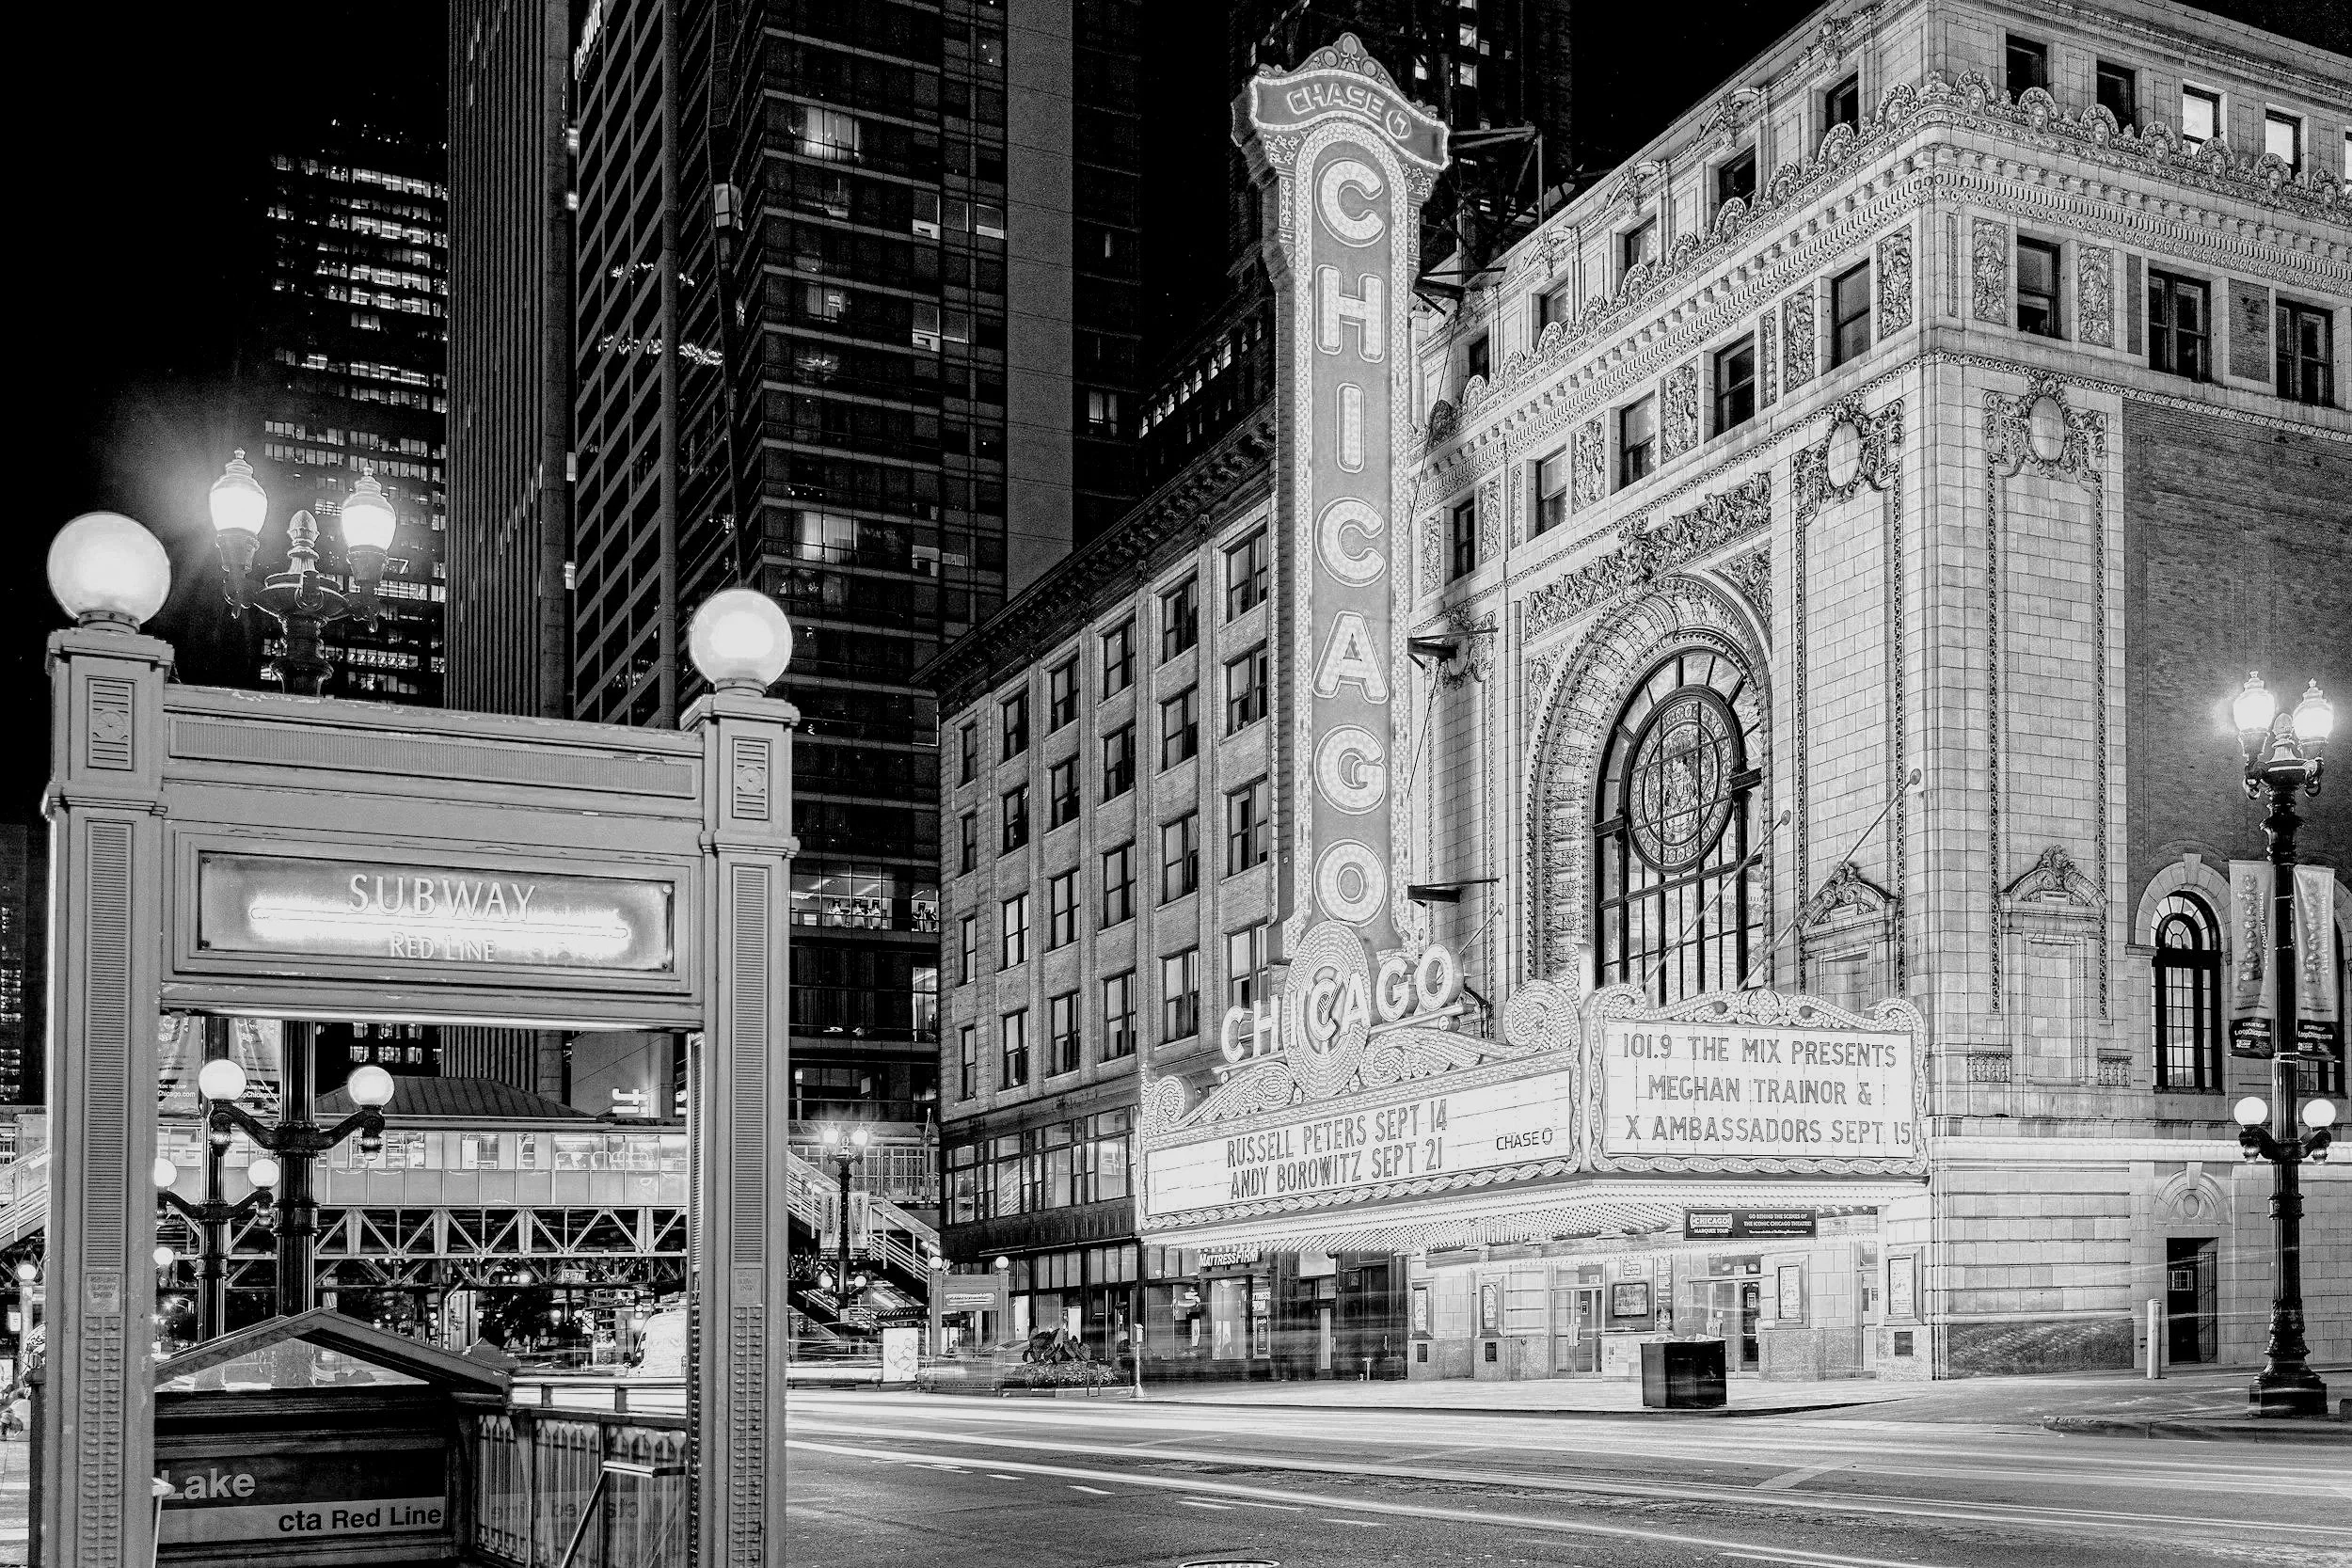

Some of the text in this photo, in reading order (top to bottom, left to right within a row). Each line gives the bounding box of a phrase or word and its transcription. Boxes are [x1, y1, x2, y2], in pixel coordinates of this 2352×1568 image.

[1286, 82, 1386, 121] CHASE
[1312, 157, 1389, 928] CHICAGO
[349, 874, 535, 922] SUBWAY
[389, 932, 496, 963] RED LINE
[2260, 922, 2268, 948] COMEDY
[1222, 942, 1465, 1064] CHICAGO
[1623, 1033, 1898, 1068] 101.9 THE MIX PRESENTS
[1648, 1074, 1872, 1106] MEGHAN TRAINOR &
[1227, 1098, 1448, 1168] RUSSELL PETERS SEPT 14
[1496, 1132, 1540, 1151] CHASE
[1626, 1115, 1911, 1145] X AMBASSADORS SEPT 15
[1230, 1136, 1442, 1200] ANDY BOROWITZ SEPT 21
[161, 1467, 256, 1500] Lake
[278, 1505, 442, 1532] cta Red Line
